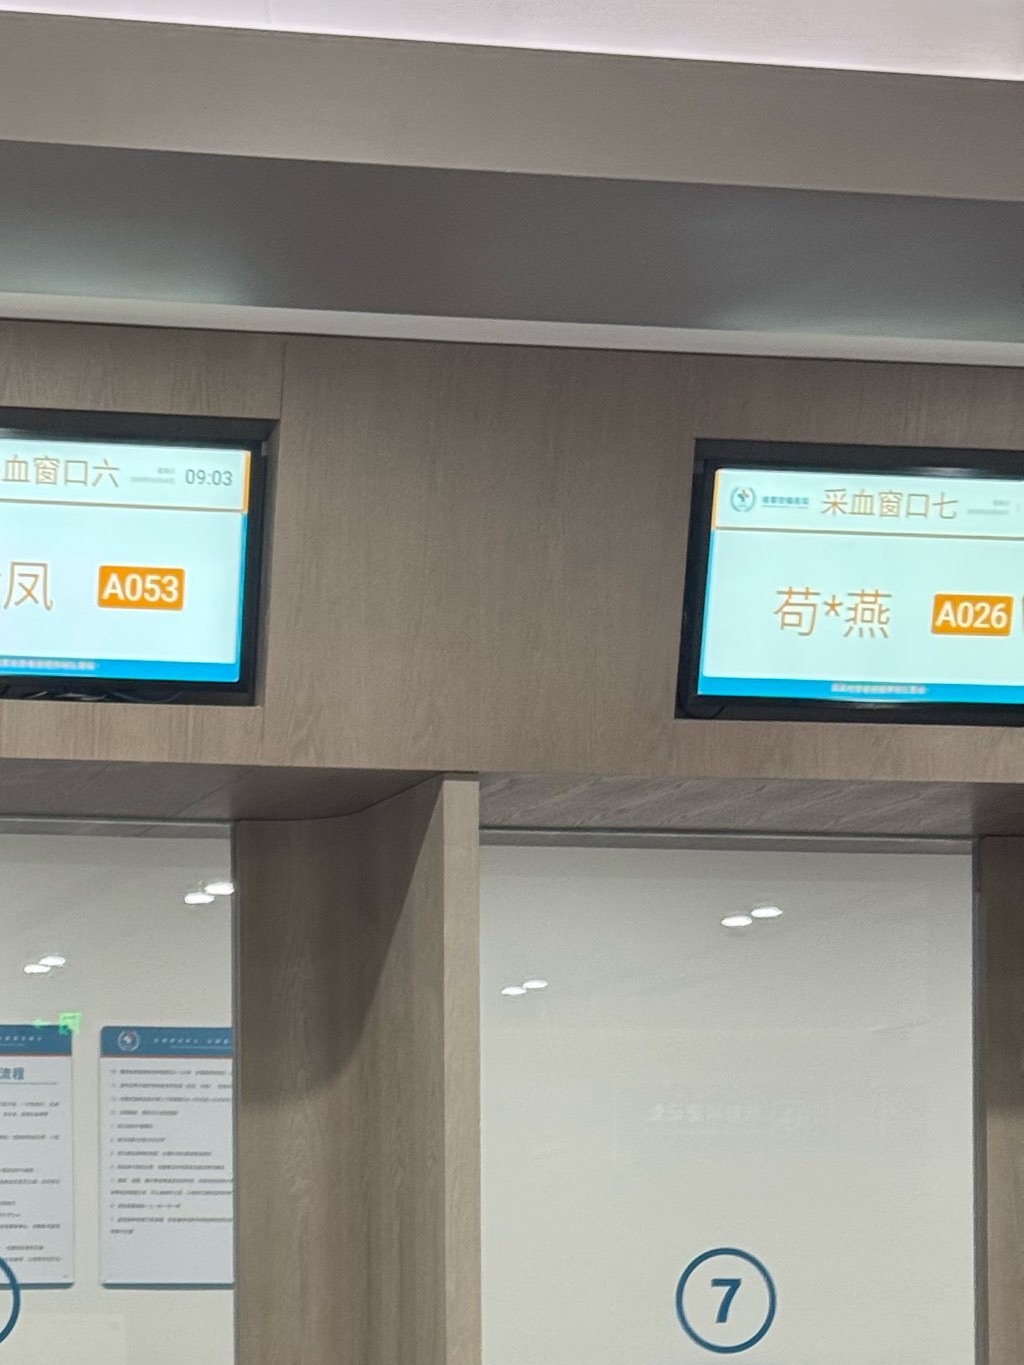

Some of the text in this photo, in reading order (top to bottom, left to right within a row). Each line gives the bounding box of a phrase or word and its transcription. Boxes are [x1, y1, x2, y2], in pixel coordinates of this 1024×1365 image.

[185, 468, 233, 487] 09:03
[820, 488, 958, 519] 采血窗口七
[102, 576, 179, 603] A053
[935, 602, 1008, 629] A026
[711, 1279, 742, 1324] 7
